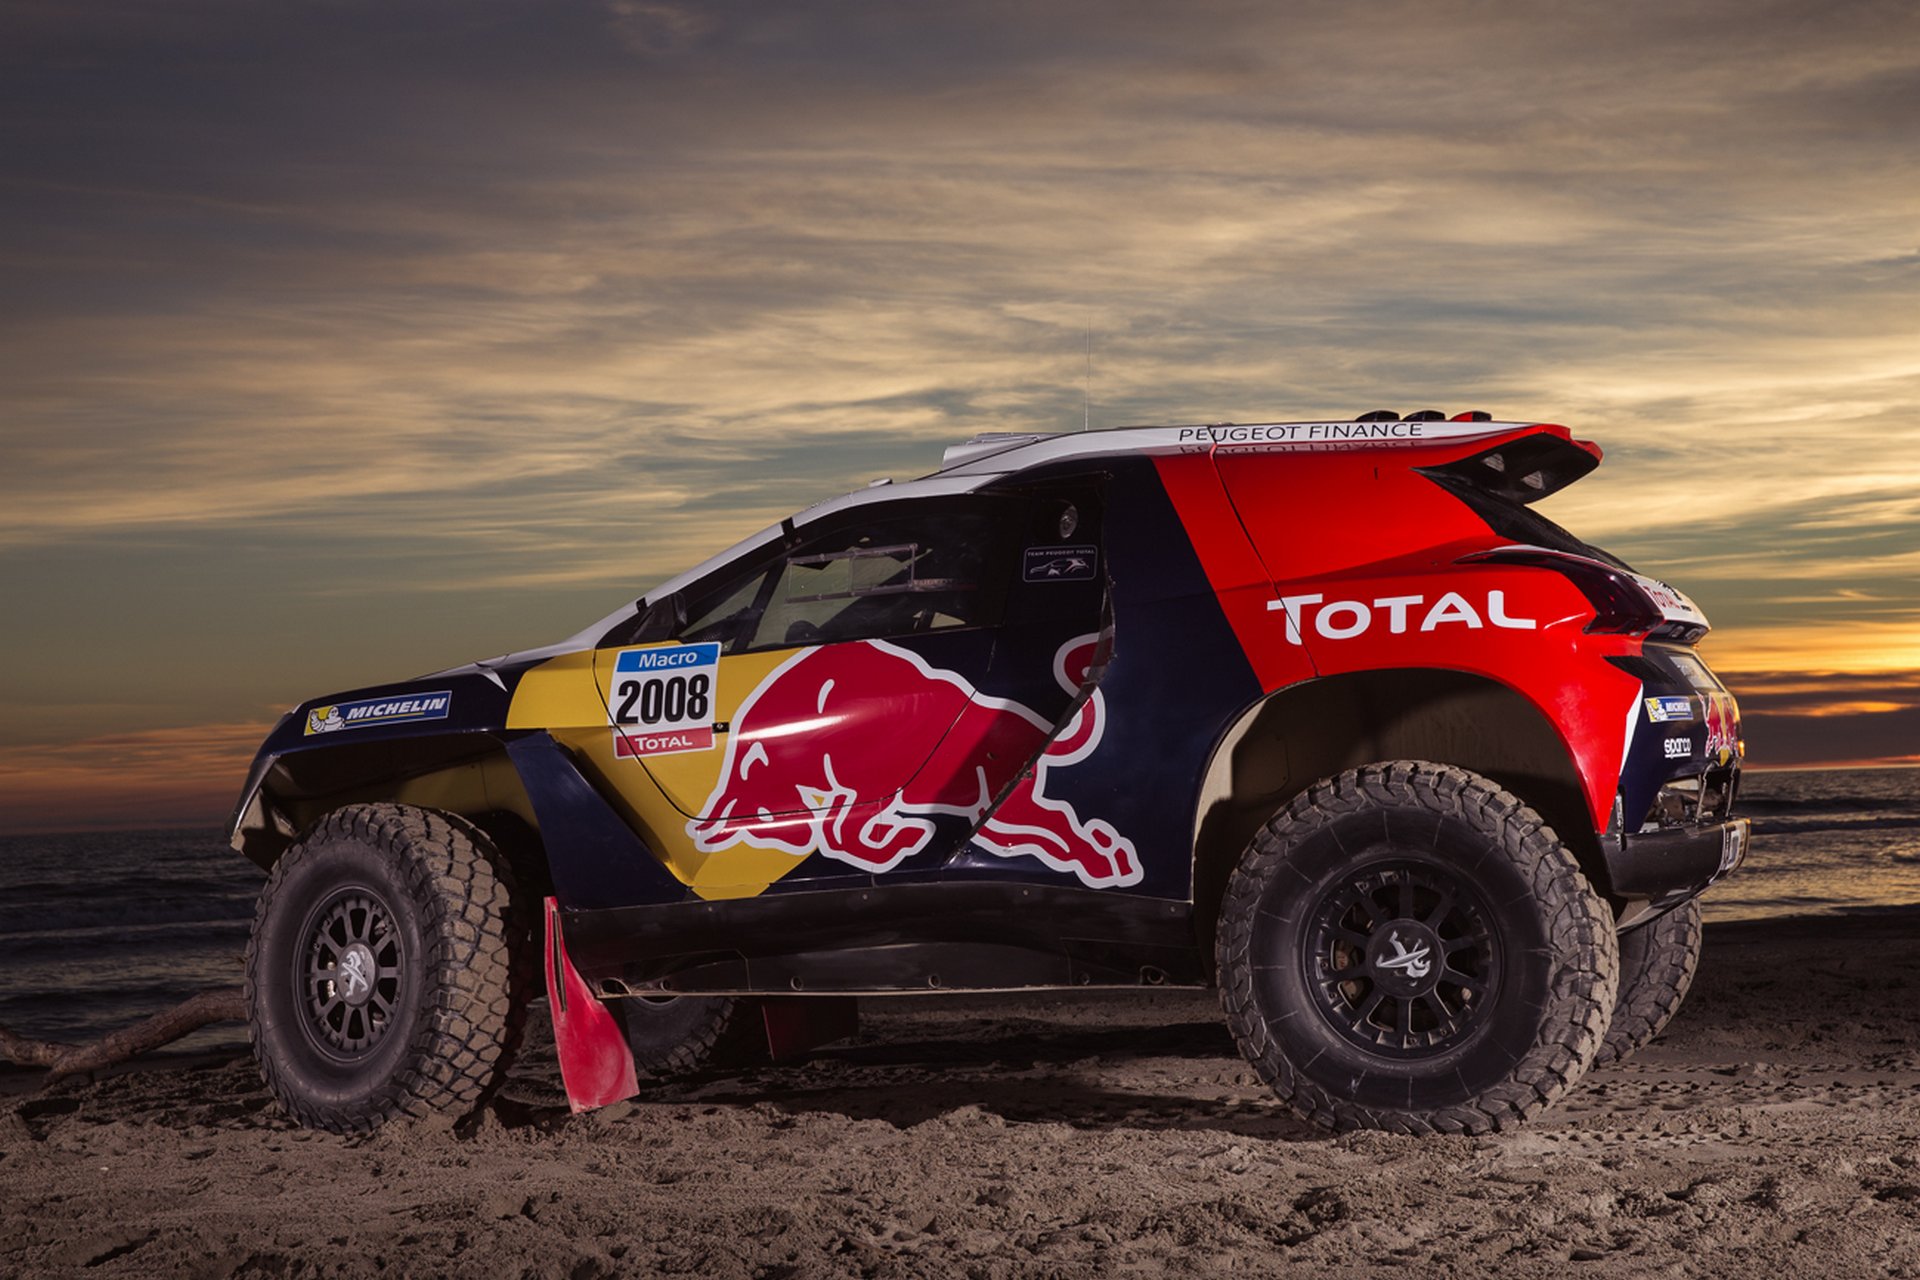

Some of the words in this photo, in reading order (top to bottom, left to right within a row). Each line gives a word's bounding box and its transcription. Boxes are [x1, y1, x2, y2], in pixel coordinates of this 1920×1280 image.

[1179, 426, 1301, 442] PEUGEOT
[1309, 423, 1423, 439] FINANCE
[638, 652, 698, 668] Macro
[346, 697, 447, 720] MICHELIN
[616, 673, 710, 725] 2008
[634, 735, 693, 751] TOTAL
[1664, 738, 1692, 758] sparco
